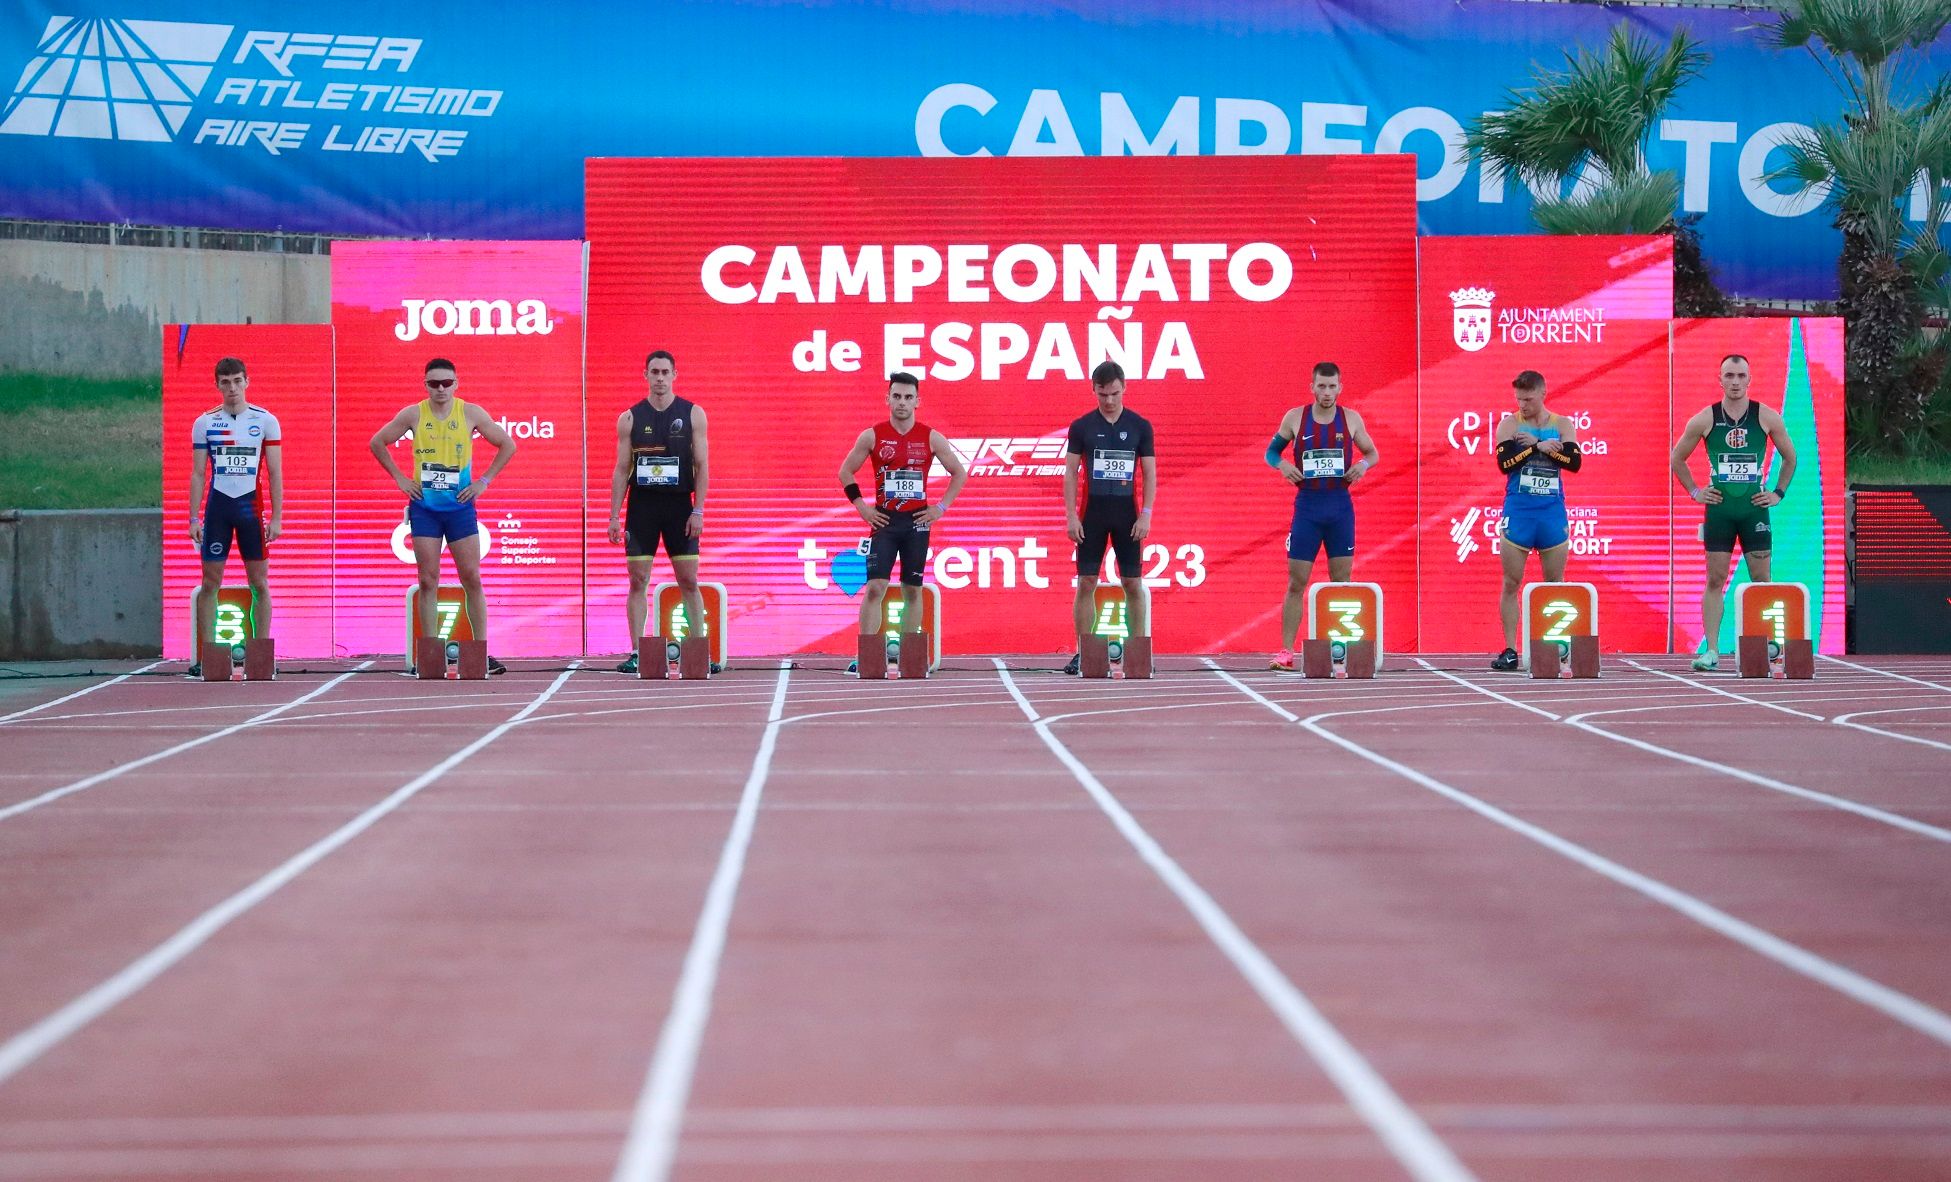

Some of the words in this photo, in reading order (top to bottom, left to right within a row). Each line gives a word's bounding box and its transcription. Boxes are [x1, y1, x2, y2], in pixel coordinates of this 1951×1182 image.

[233, 30, 423, 76] RFEA
[214, 78, 503, 117] ATLETISMO
[194, 118, 311, 155] AIRE
[321, 125, 469, 163] LIBRE
[701, 242, 1293, 304] CAMPEONATO
[1498, 308, 1606, 325] AJUNTAMENT
[1498, 323, 1606, 343] TORRENT
[792, 329, 862, 372] de
[884, 305, 1205, 381] ESPAÑA
[226, 456, 247, 466] 103
[1104, 460, 1126, 471] 398
[1314, 459, 1334, 469] 158
[1728, 463, 1749, 474] 125
[432, 472, 446, 482] 29
[971, 464, 1081, 477] ATLETISM
[895, 480, 915, 491] 188
[1531, 477, 1551, 488] 109
[501, 536, 538, 549] Consejo
[501, 546, 540, 556] Superior
[860, 540, 870, 554] 5
[501, 556, 513, 564] de
[514, 555, 557, 566] Deportes
[215, 603, 245, 647] 8
[436, 602, 461, 640] 7
[1095, 601, 1129, 645] 4
[1327, 601, 1365, 644] 3
[1542, 600, 1579, 643] 2
[1762, 600, 1785, 645] 1
